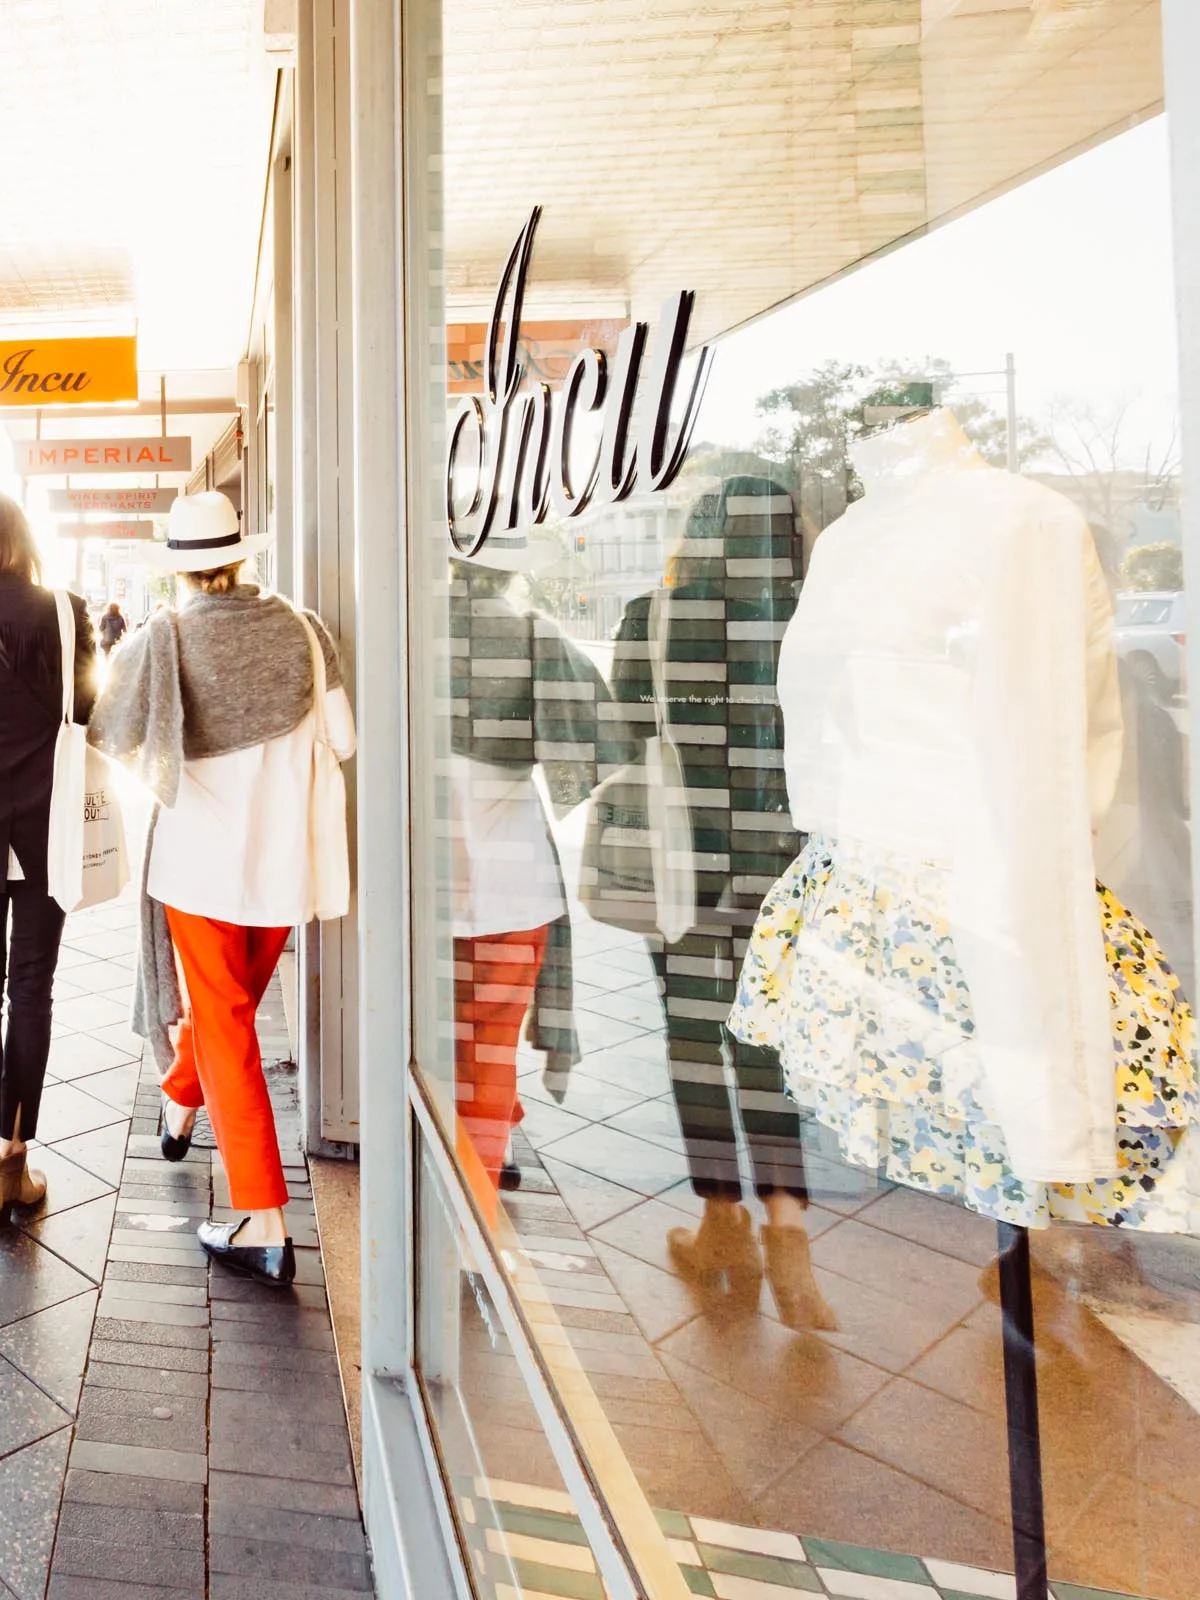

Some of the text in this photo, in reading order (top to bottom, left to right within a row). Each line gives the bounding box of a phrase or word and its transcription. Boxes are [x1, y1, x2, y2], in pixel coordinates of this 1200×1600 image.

[445, 204, 716, 558] Incu
[28, 445, 174, 466] IMPERIAL
[67, 491, 99, 500] WINE
[116, 491, 159, 500] SPIRIT
[640, 694, 654, 703] We
[689, 694, 702, 703] the
[704, 694, 724, 706] right
[726, 695, 735, 703] to
